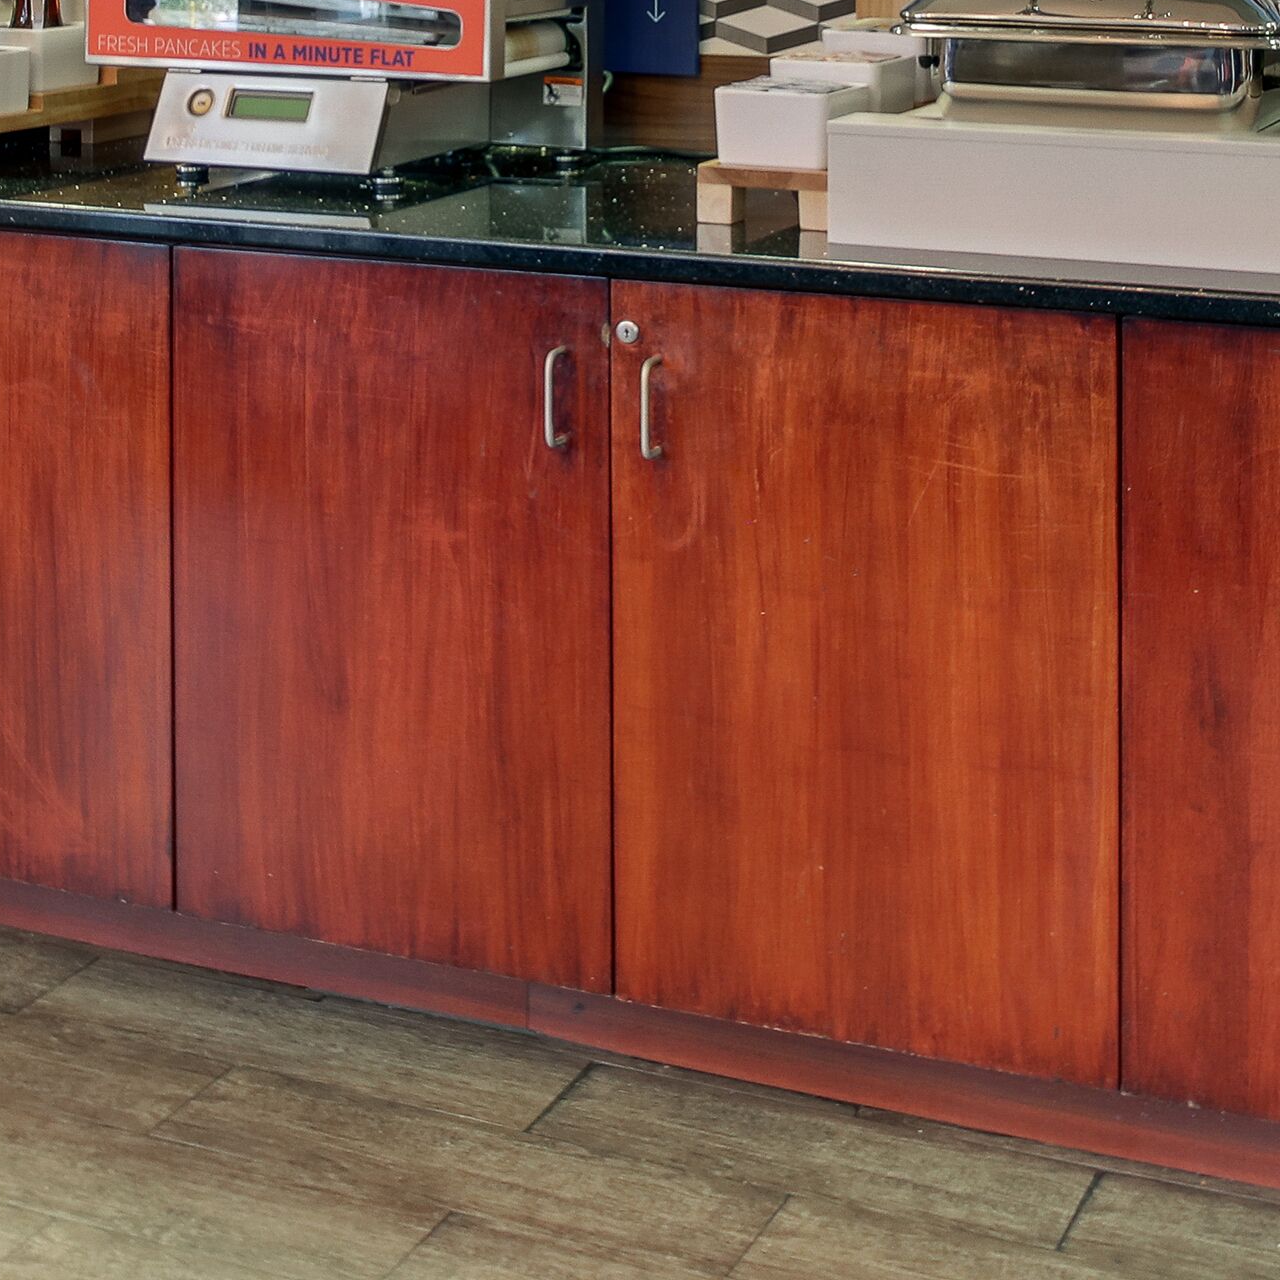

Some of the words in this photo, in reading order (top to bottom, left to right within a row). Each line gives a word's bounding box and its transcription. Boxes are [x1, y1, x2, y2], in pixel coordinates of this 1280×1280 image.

[97, 33, 148, 54] FRESH
[154, 37, 241, 58] PANCAKES
[248, 42, 267, 59] IN
[273, 44, 286, 60] A
[292, 45, 364, 64] MINUTE
[370, 49, 415, 67] FLAT
